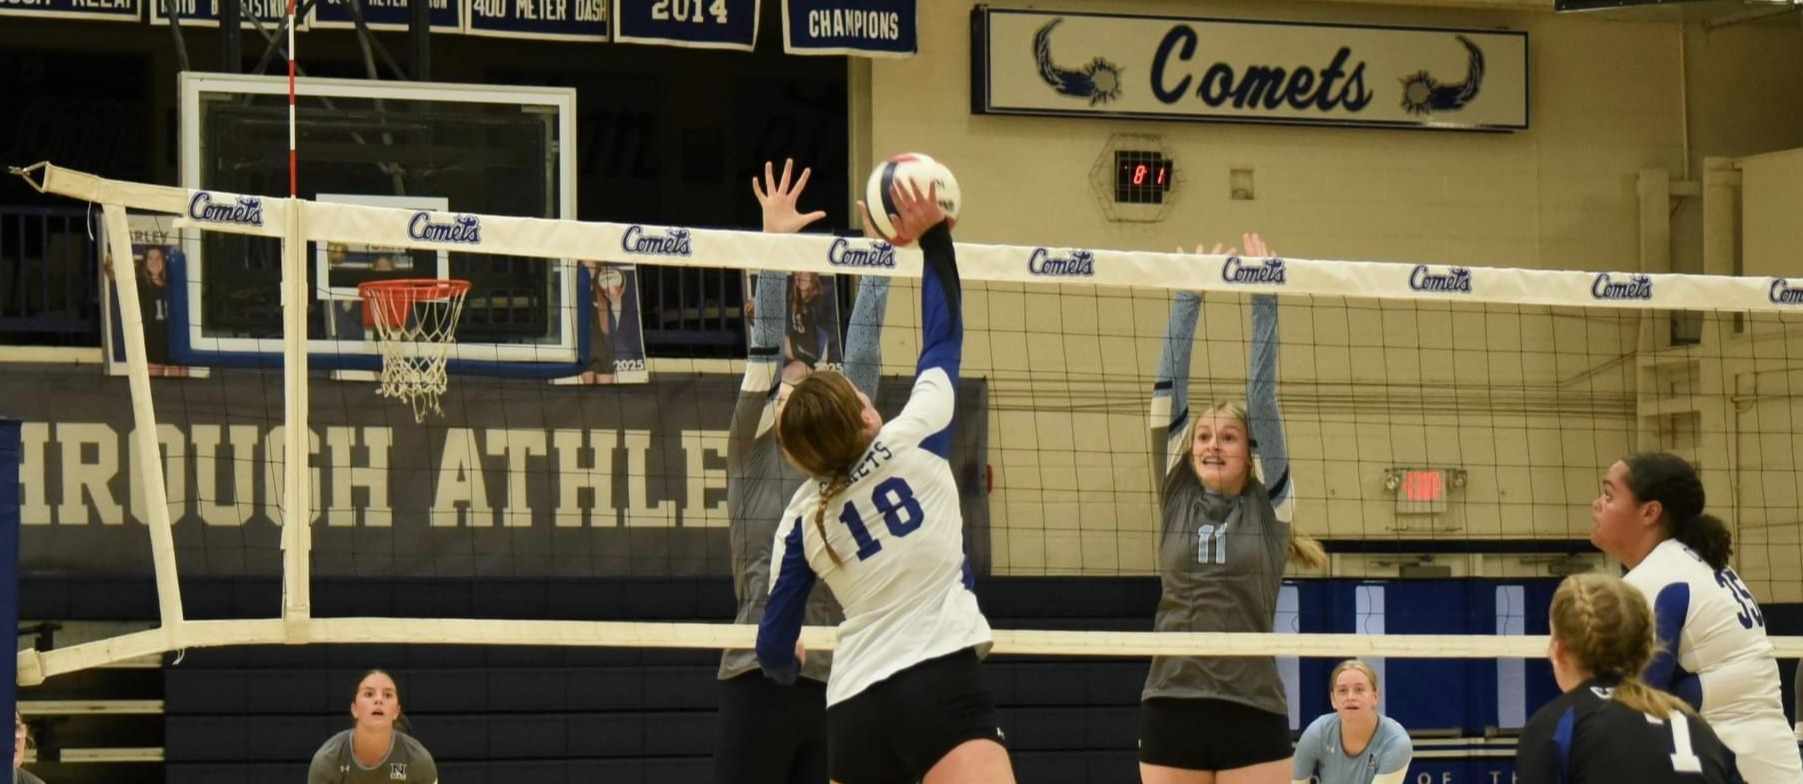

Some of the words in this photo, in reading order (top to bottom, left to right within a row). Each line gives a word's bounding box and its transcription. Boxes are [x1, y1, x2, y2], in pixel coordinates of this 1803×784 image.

[473, 0, 506, 17] 400
[515, 0, 567, 20] METER
[575, 0, 607, 21] DASH
[652, 0, 728, 24] 2014
[808, 8, 899, 40] CHAMPIONS
[1150, 24, 1373, 112] Comets
[188, 190, 263, 226] Comets
[408, 211, 481, 244] Comets
[622, 224, 692, 256] Comets
[828, 237, 896, 268] Comets
[1028, 247, 1094, 276] Comets
[1222, 256, 1286, 284] Comets
[1409, 264, 1472, 292] Comets
[1591, 272, 1652, 299] Comets
[613, 359, 645, 371] 2025
[838, 476, 925, 561] 18
[1198, 522, 1228, 564] 11
[1713, 569, 1764, 630] 35
